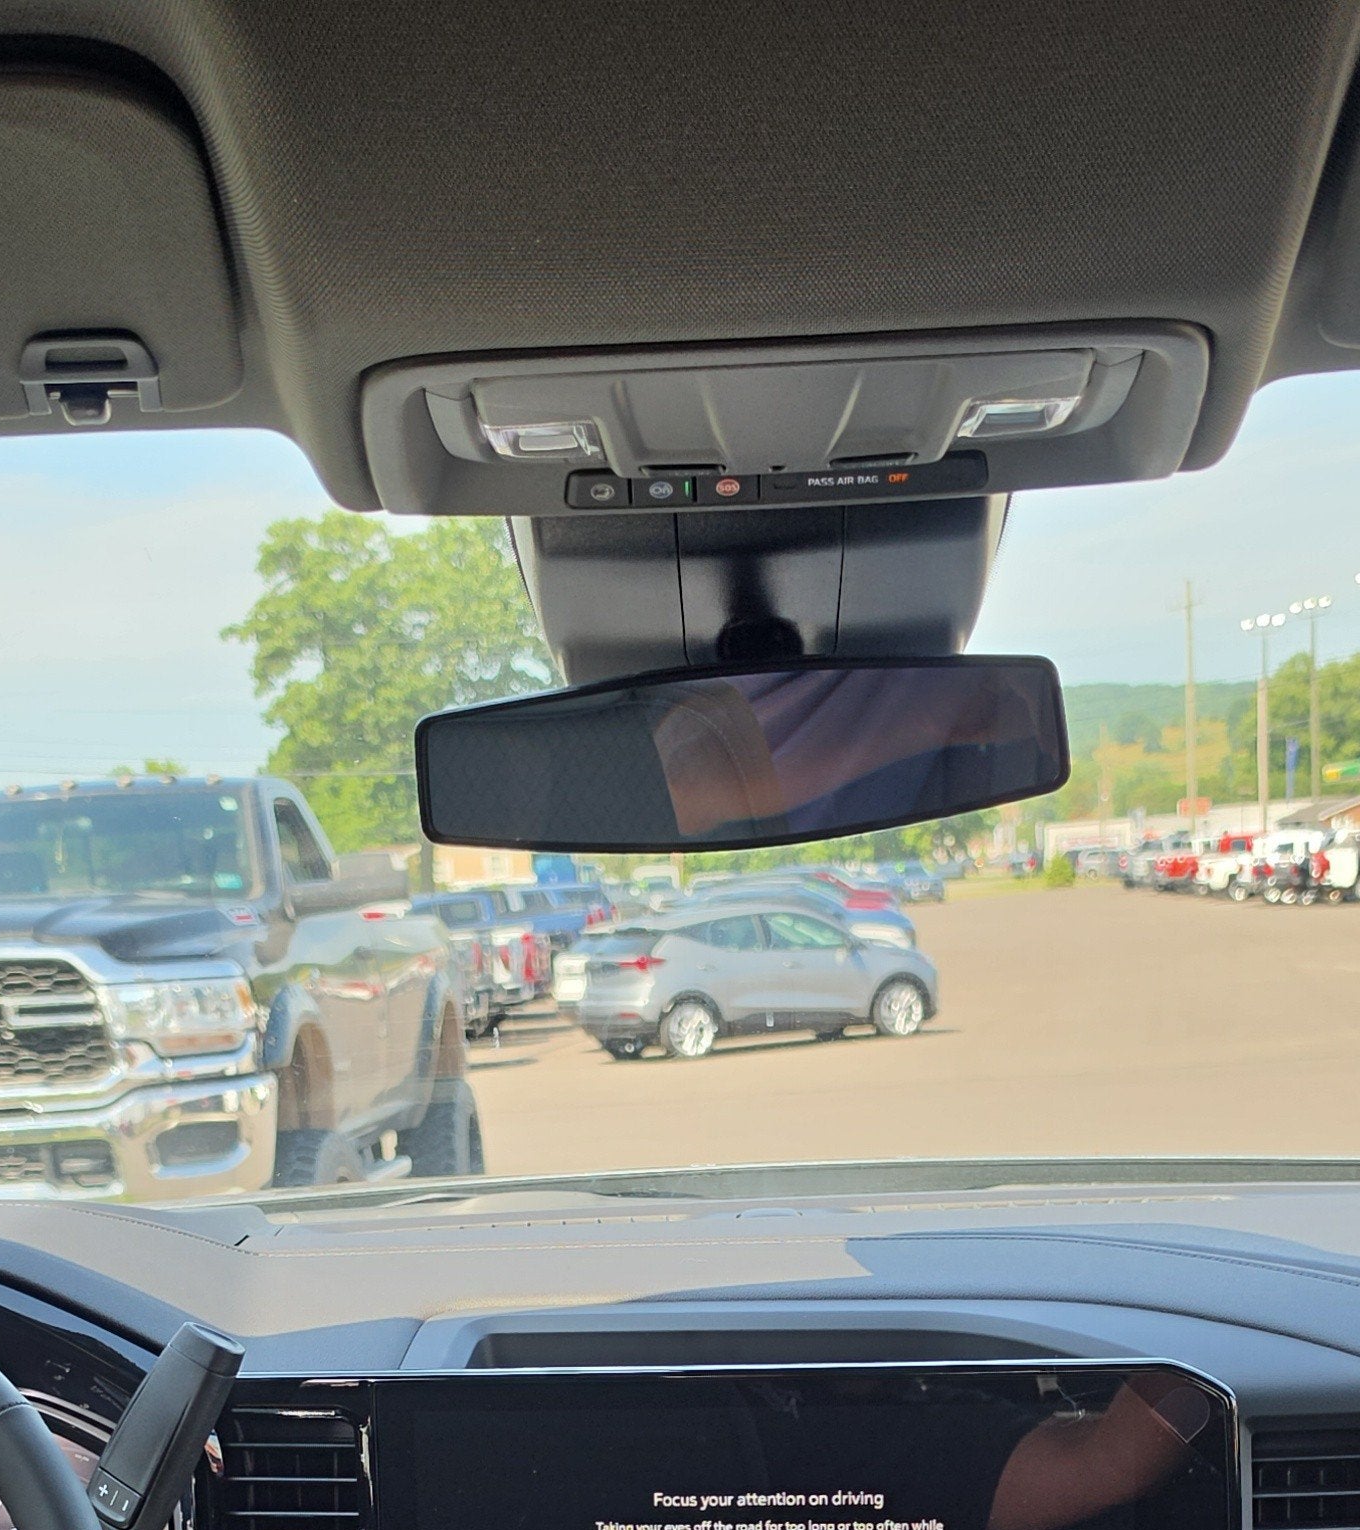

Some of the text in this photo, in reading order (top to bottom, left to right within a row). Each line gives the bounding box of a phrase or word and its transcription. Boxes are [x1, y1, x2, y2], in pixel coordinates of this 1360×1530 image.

[808, 475, 879, 486] PASS AIR BAG
[888, 473, 908, 483] OFF
[653, 1490, 885, 1511] Focus your attention on driving
[876, 1520, 909, 1530] often
